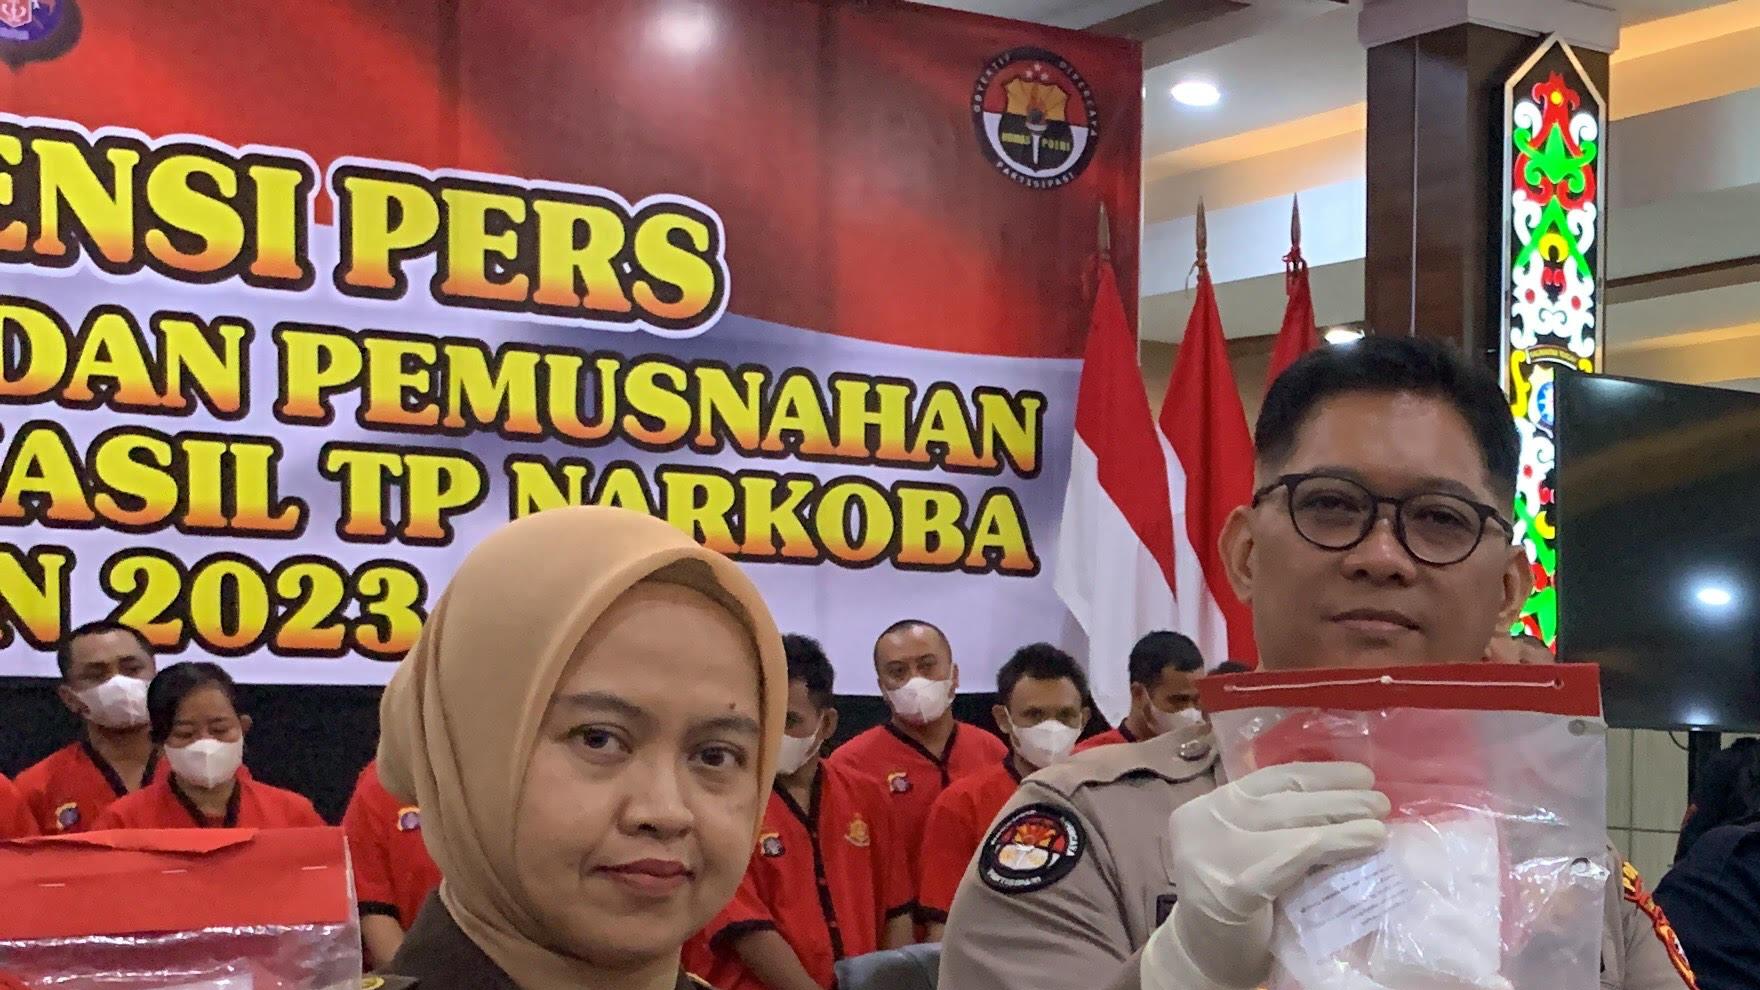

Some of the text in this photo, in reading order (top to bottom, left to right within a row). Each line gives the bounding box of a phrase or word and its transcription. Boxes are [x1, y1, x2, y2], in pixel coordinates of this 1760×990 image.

[343, 174, 716, 321] PERS
[0, 303, 1043, 473] DAN PEMUSNAHAN
[325, 446, 483, 541] TP
[108, 553, 426, 655] 2023
